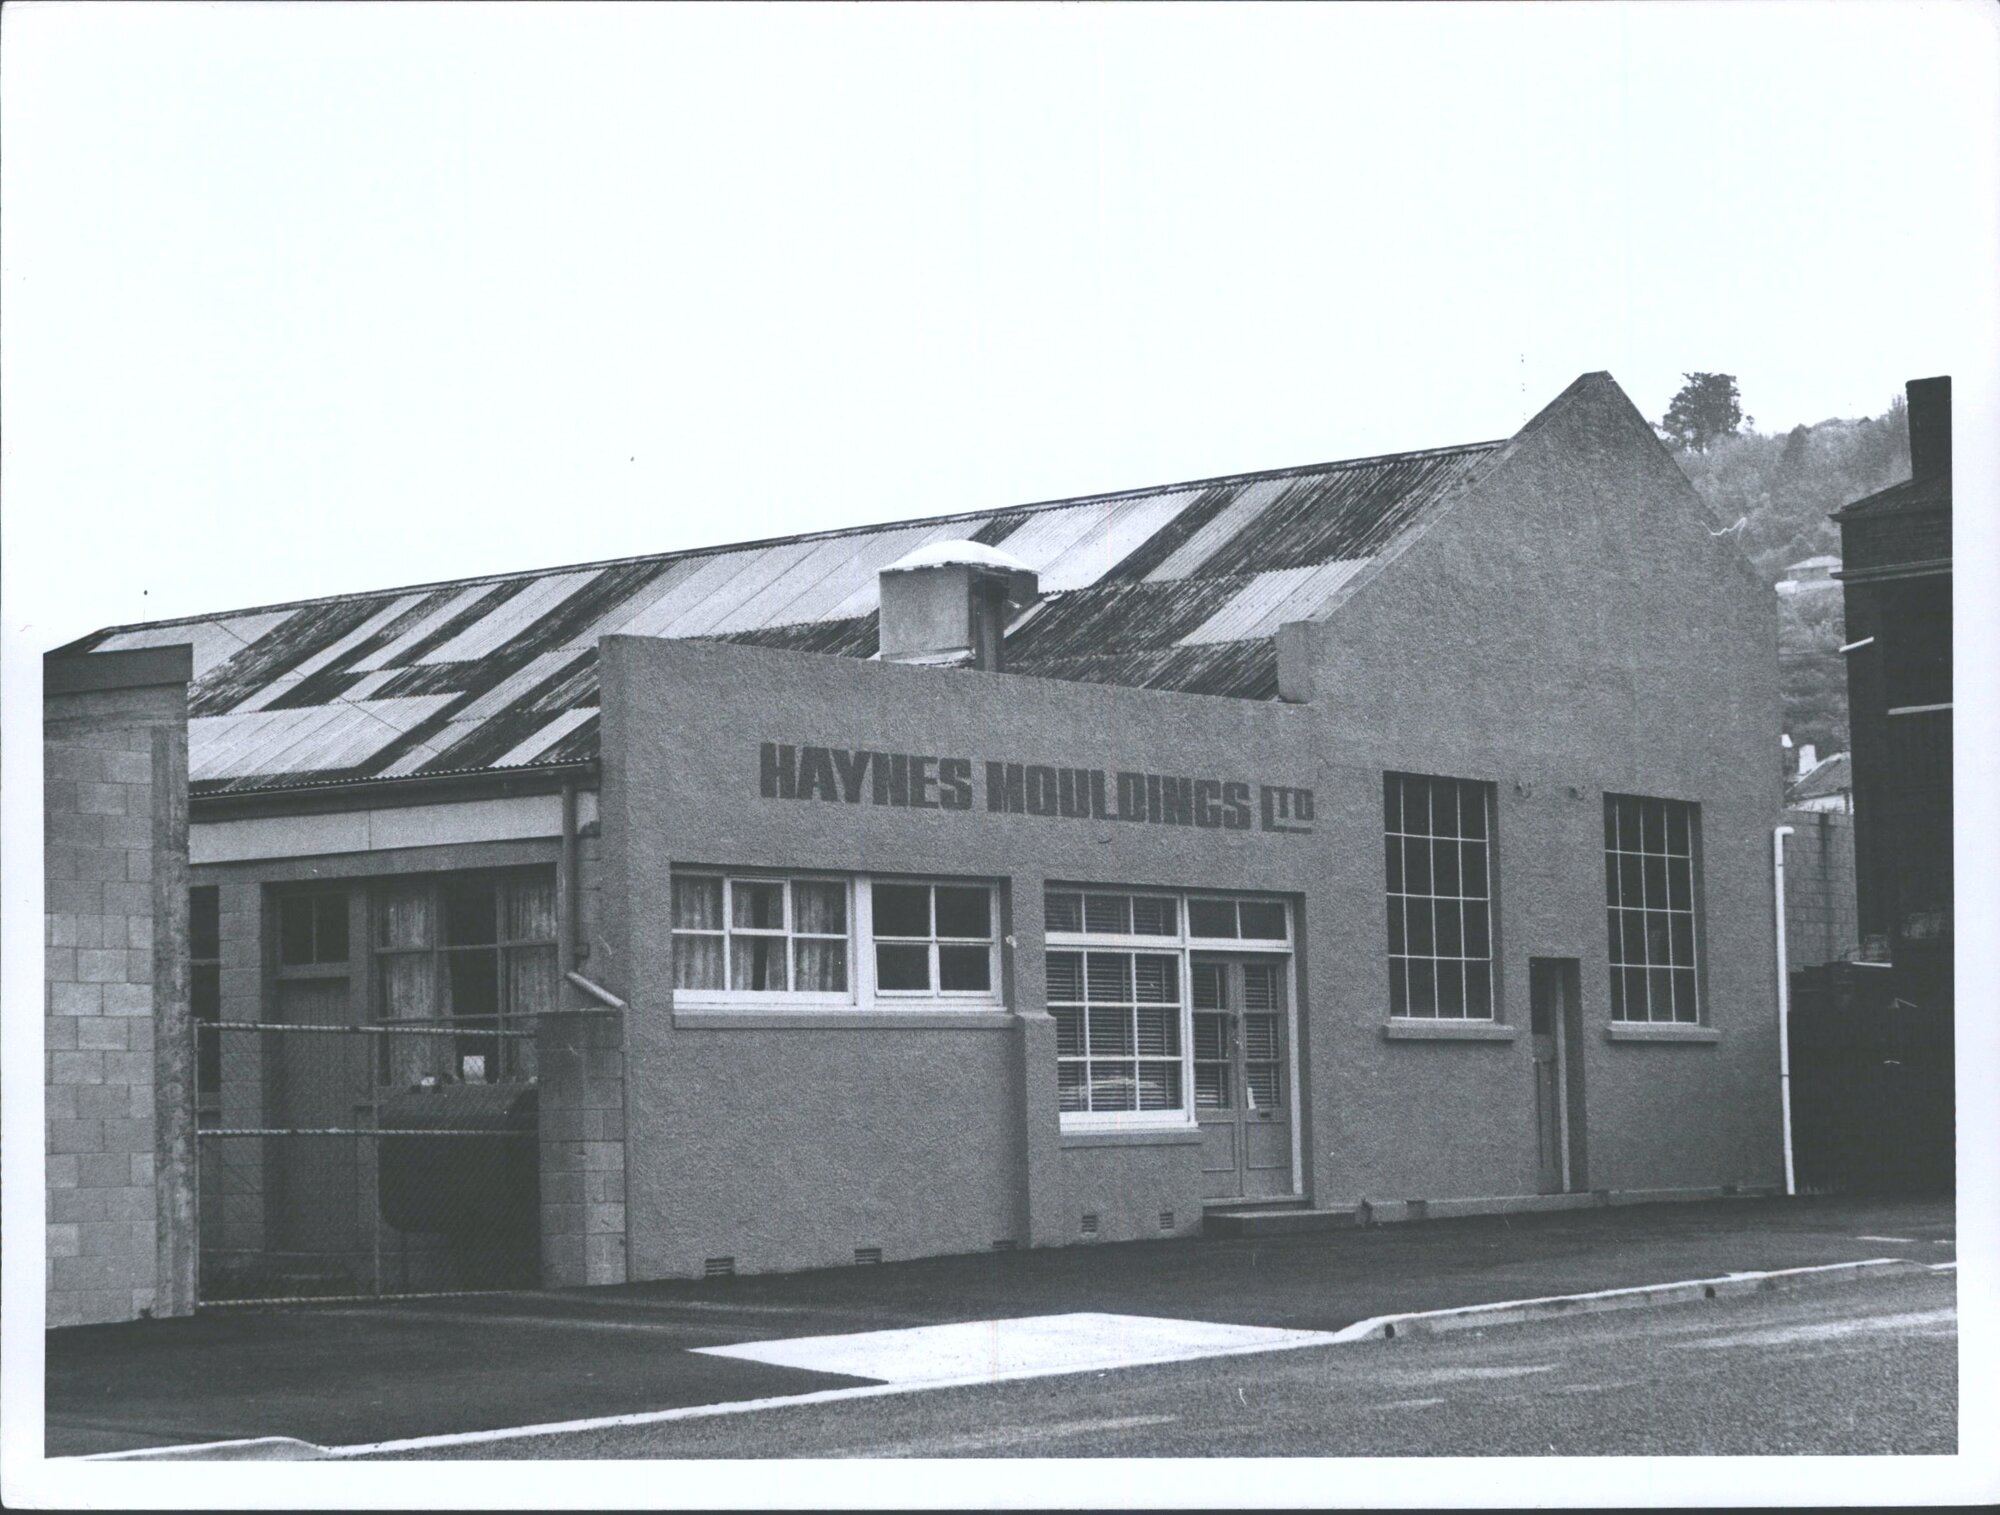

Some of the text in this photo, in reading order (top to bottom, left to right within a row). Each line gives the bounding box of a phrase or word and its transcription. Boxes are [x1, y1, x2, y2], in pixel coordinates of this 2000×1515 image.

[760, 742, 1315, 834] HAYNES MOULDINGS LTD
